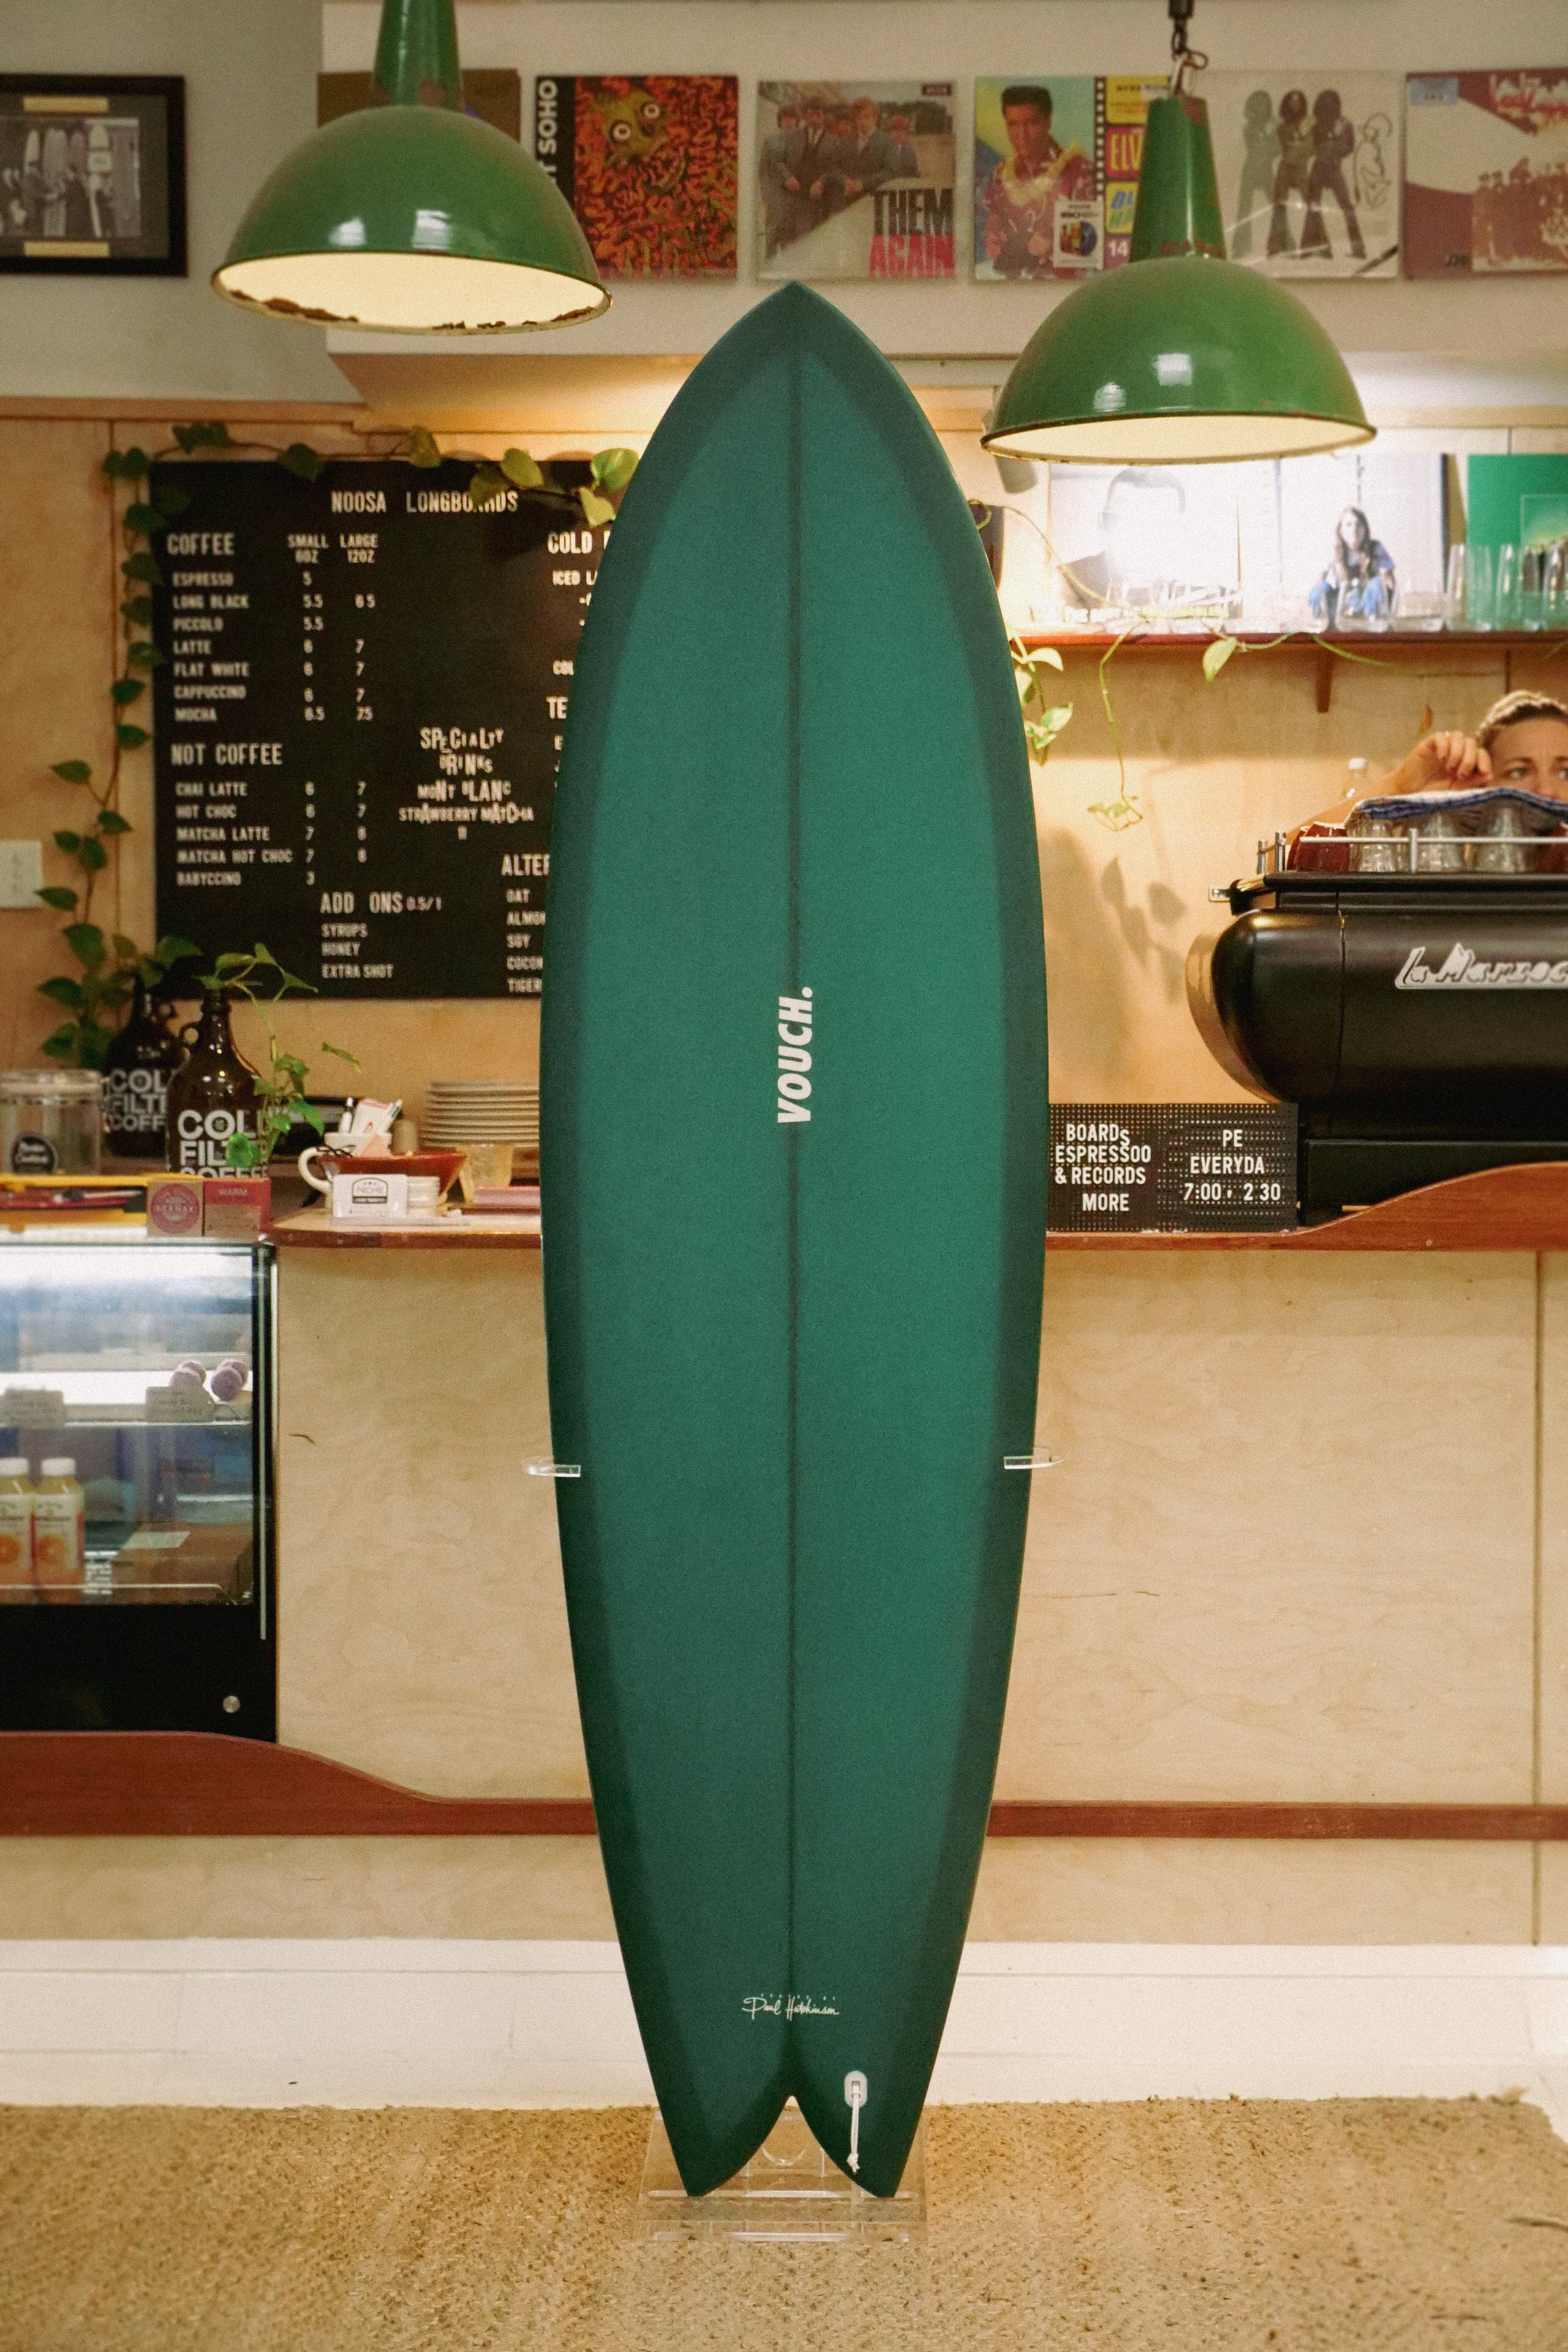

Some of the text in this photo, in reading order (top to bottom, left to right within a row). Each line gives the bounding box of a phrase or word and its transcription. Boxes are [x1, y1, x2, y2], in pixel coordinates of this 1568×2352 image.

[538, 80, 557, 154] SOHO
[873, 189, 953, 235] THEM
[869, 234, 955, 278] AGAIN
[332, 491, 518, 513] NOOSA LONGBORDS
[167, 533, 234, 555] COFFEE
[288, 533, 377, 548] SMALL LARGE
[548, 531, 592, 554] COLD
[173, 572, 233, 586] ESPRESSO
[552, 571, 580, 586] ICED
[210, 595, 249, 609] BLACK
[173, 639, 211, 654] LATTE
[356, 639, 364, 653] 7
[174, 662, 205, 677] FLAT
[211, 662, 248, 676] WHITE
[356, 662, 364, 676] 7
[175, 685, 246, 699] CAPPUCCINO
[356, 688, 364, 702] 7
[175, 708, 217, 721] MOCHA
[546, 697, 568, 718] TE
[420, 727, 503, 753] SPECIALTY
[172, 743, 282, 765] NOT COFFEE
[176, 783, 203, 796] CHAI
[209, 782, 247, 796] LATTE
[358, 781, 366, 795] 7
[176, 804, 199, 818] HOT
[206, 804, 236, 818] CHOC
[358, 804, 366, 818] 7
[399, 804, 478, 823] STRAWBERRY
[176, 827, 226, 840] MATCHA
[232, 826, 270, 841] LATTE
[306, 826, 314, 840] 7
[178, 850, 226, 863] MATCHA
[232, 849, 255, 863] HOT
[262, 849, 292, 862] CHOC
[306, 848, 314, 862] 7
[320, 892, 354, 913] ADD
[369, 892, 402, 913] ONS
[507, 889, 530, 903] OAT
[322, 923, 368, 937] SYRUPS
[322, 942, 360, 956] HONEY
[507, 933, 530, 948] SOY
[322, 964, 394, 978] EXTRA SHOT
[777, 987, 813, 1123] VOUCH.
[111, 1069, 167, 1092] COL
[113, 1115, 166, 1131] COFF
[1066, 1124, 1130, 1146] BOARDS
[1223, 1129, 1243, 1147] PE
[1190, 1156, 1265, 1174] EVERYDA
[1055, 1167, 1146, 1185] & RECORDS
[1183, 1183, 1221, 1200] 7:00
[1082, 1193, 1129, 1211] MORE
